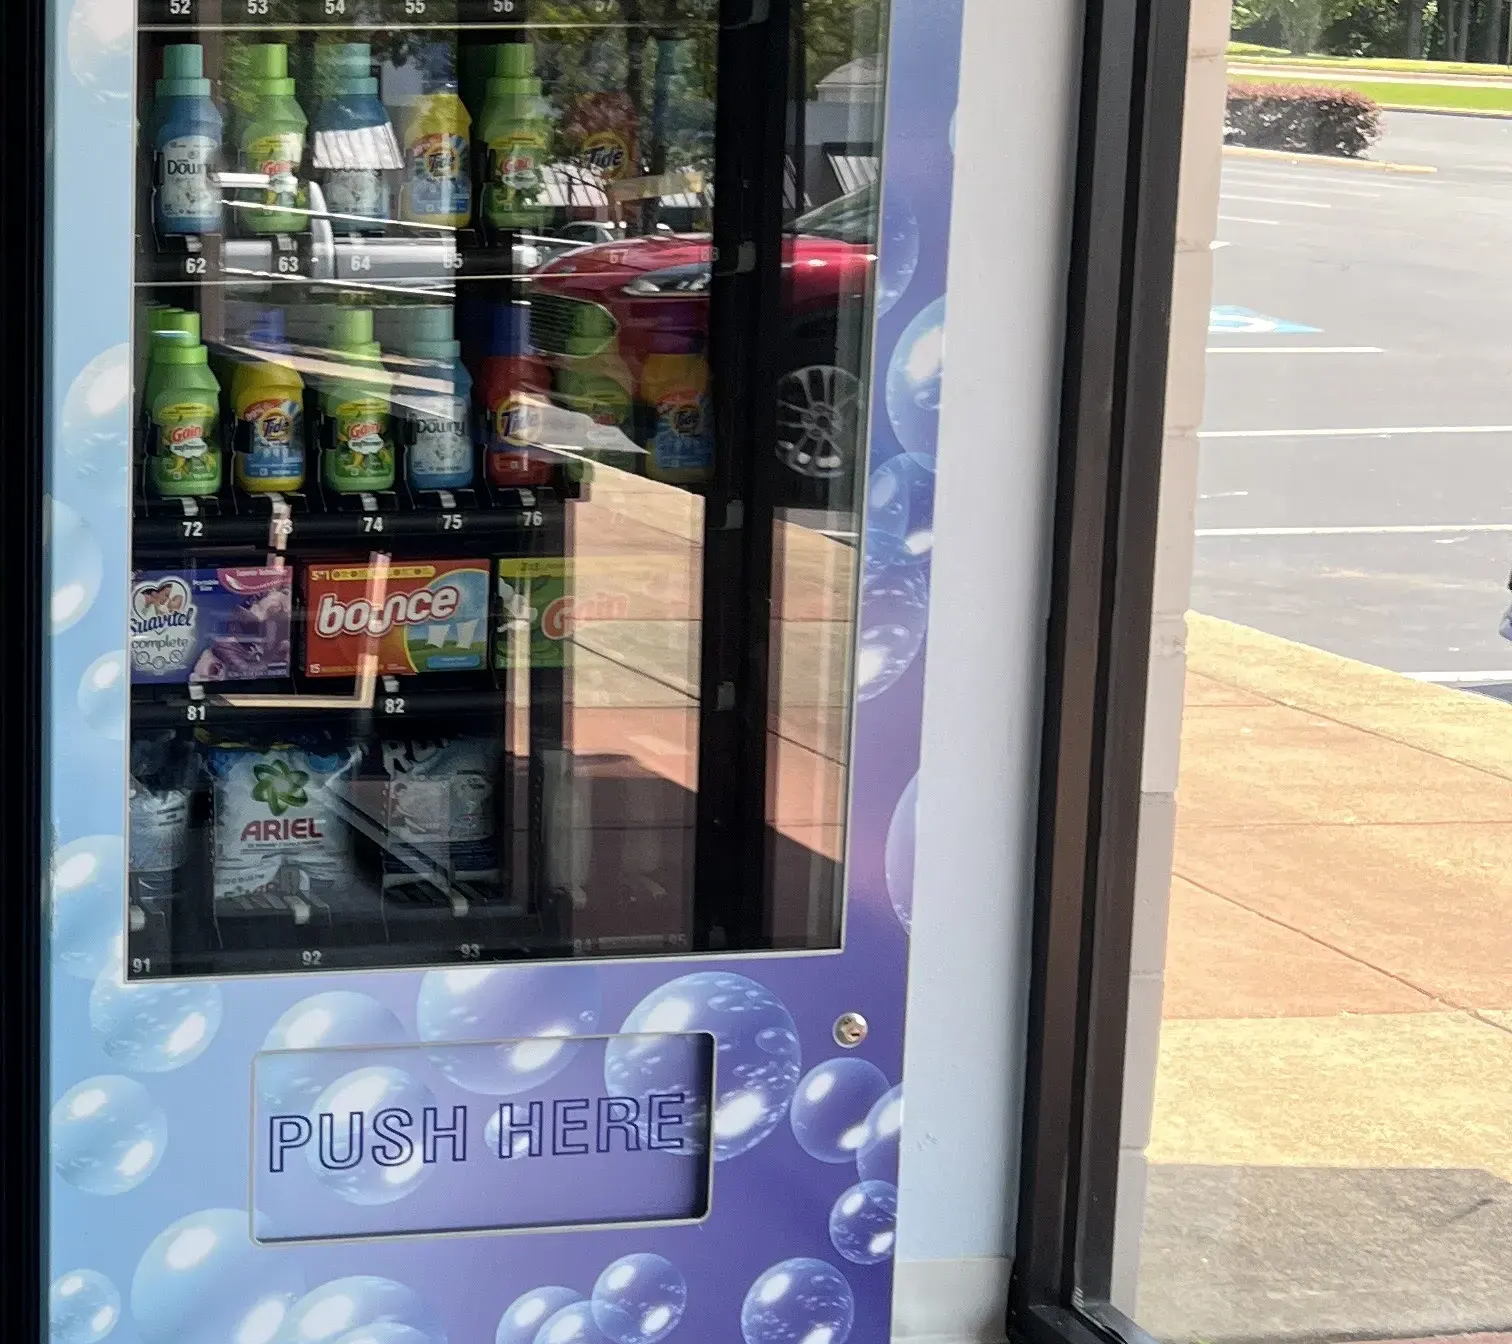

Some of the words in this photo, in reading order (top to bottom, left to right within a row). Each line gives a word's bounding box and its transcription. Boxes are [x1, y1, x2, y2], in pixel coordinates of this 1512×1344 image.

[185, 257, 207, 274] 62
[278, 256, 300, 273] 63
[350, 255, 372, 272] 64
[415, 418, 465, 436] Downy
[362, 516, 384, 534] 74
[441, 514, 464, 531] 75
[522, 511, 544, 528] 76
[182, 520, 204, 538] 72
[130, 607, 194, 635] Suavitel
[318, 587, 459, 637] bounce
[130, 635, 189, 652] complete
[186, 706, 207, 722] 81
[384, 698, 406, 715] 82
[240, 817, 325, 842] ARIEL
[131, 956, 152, 974] 91
[301, 949, 323, 967] 92
[267, 1104, 469, 1174] PUSH
[497, 1091, 686, 1159] HERE
